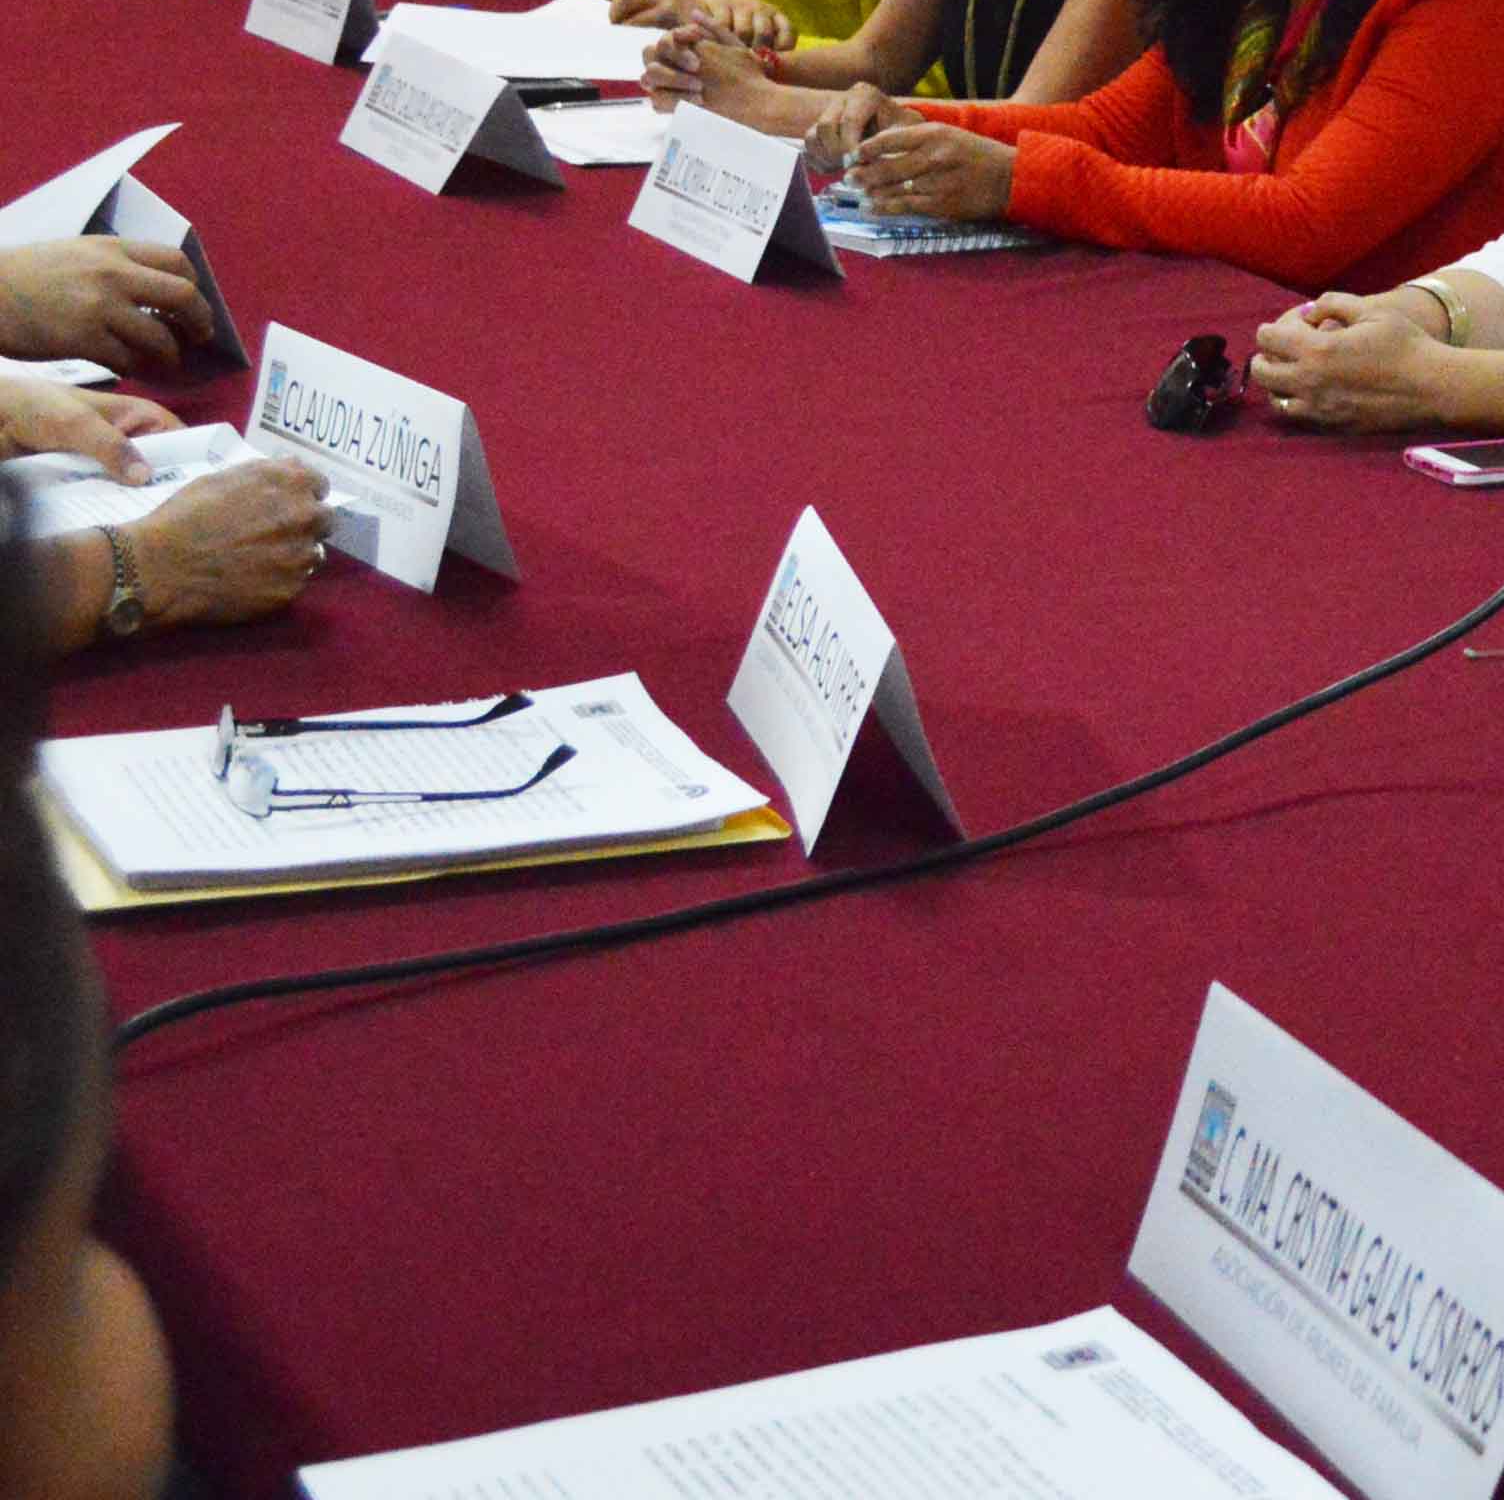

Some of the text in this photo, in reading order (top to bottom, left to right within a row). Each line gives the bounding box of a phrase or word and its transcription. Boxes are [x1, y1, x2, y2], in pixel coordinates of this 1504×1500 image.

[281, 380, 442, 495] CLAUDIA ZÚÑIGA
[1273, 1171, 1366, 1307] CRISTINA
